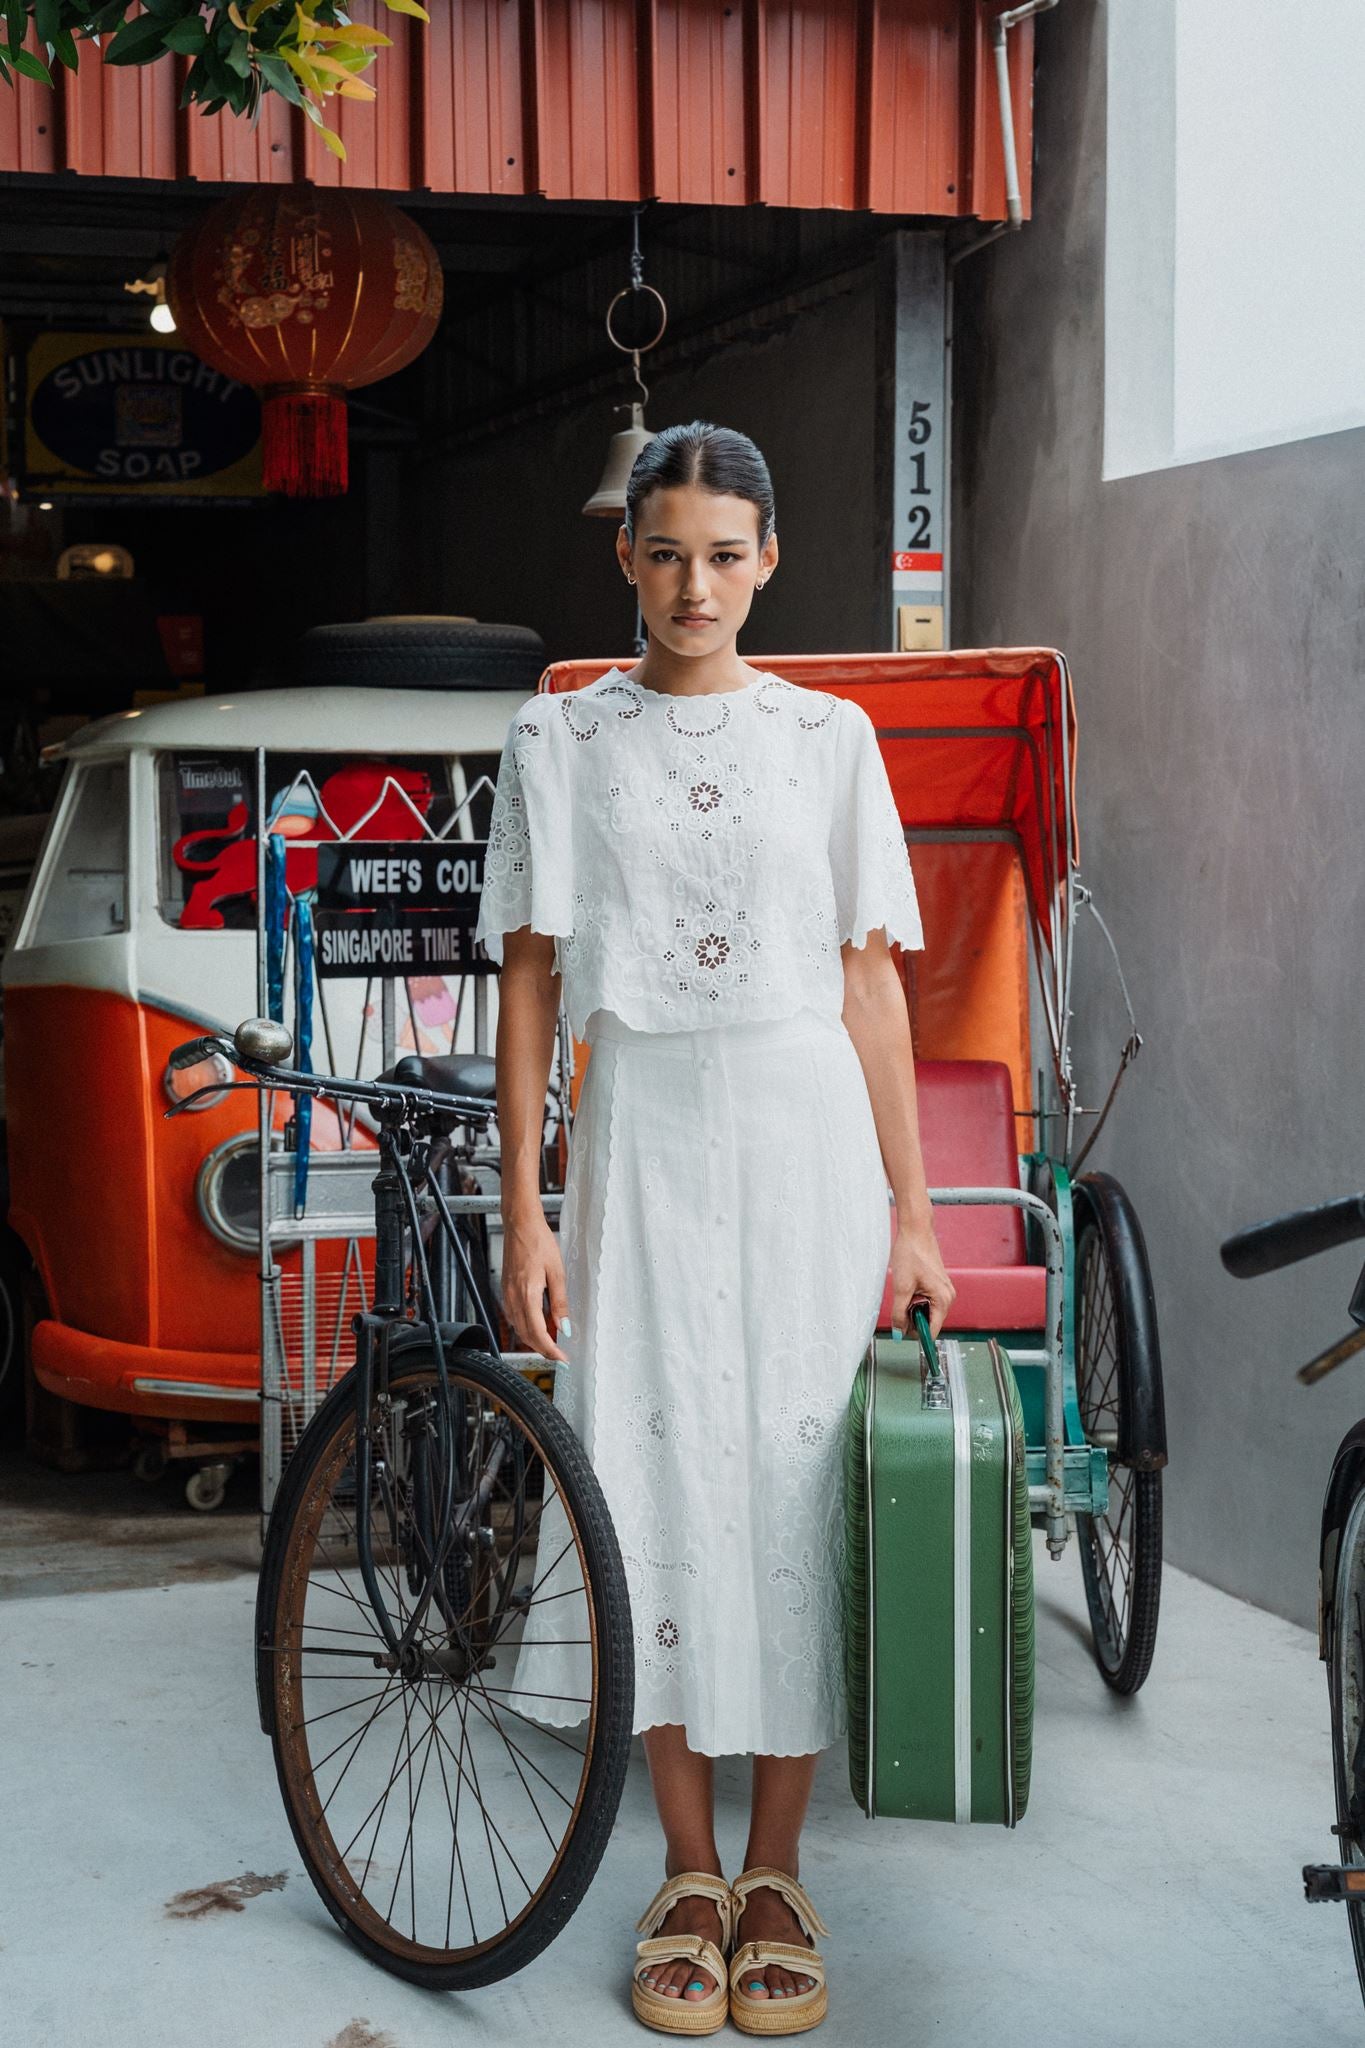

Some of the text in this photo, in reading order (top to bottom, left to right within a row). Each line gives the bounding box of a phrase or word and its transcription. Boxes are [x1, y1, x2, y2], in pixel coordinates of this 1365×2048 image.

[54, 351, 243, 403] SUNLIGHT
[96, 448, 203, 480] SOAP
[908, 401, 932, 550] 512
[350, 858, 484, 894] WEE'S COL
[321, 929, 415, 966] SINGAPORE
[421, 928, 460, 962] TIME
